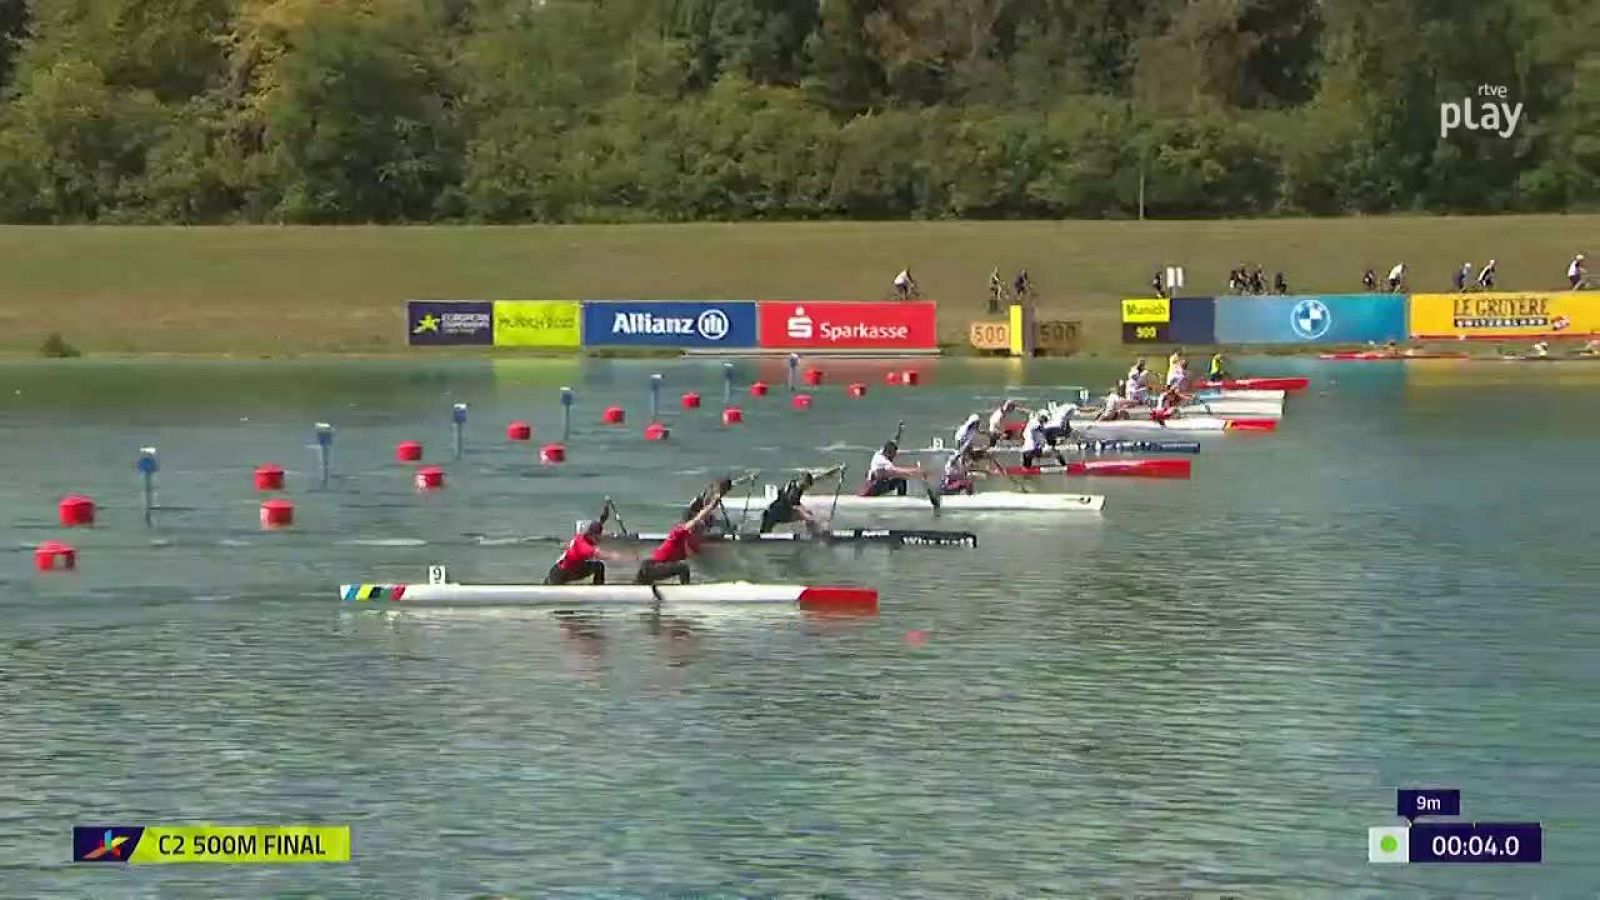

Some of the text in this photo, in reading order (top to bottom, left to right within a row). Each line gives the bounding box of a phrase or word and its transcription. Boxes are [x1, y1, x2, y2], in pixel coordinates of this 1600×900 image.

[1453, 298, 1471, 316] LE
[612, 312, 695, 335] Allianz
[820, 322, 909, 341] Sparkasse
[975, 325, 1007, 343] 500
[433, 564, 442, 581] 9
